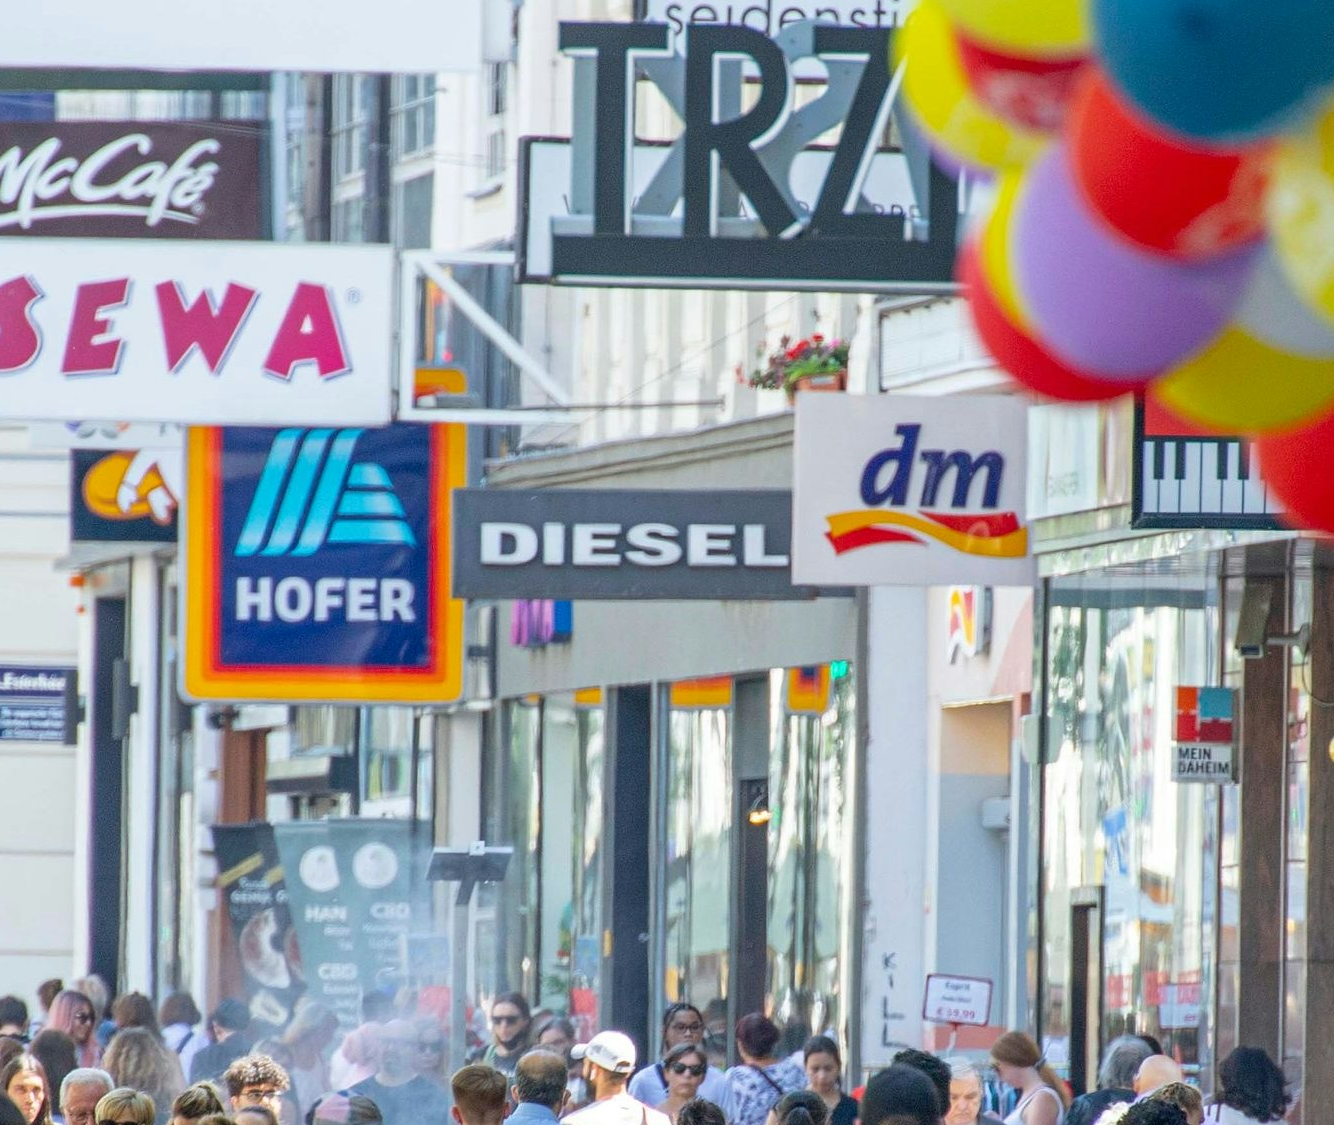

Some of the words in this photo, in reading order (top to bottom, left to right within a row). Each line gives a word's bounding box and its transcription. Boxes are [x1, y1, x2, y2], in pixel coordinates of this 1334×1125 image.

[667, 0, 898, 35] seidensti
[860, 423, 1005, 508] dm
[480, 521, 790, 567] DIESEL
[235, 576, 417, 622] HOFER
[1178, 761, 1230, 775] DAHEIM
[1179, 747, 1212, 760] MEIN
